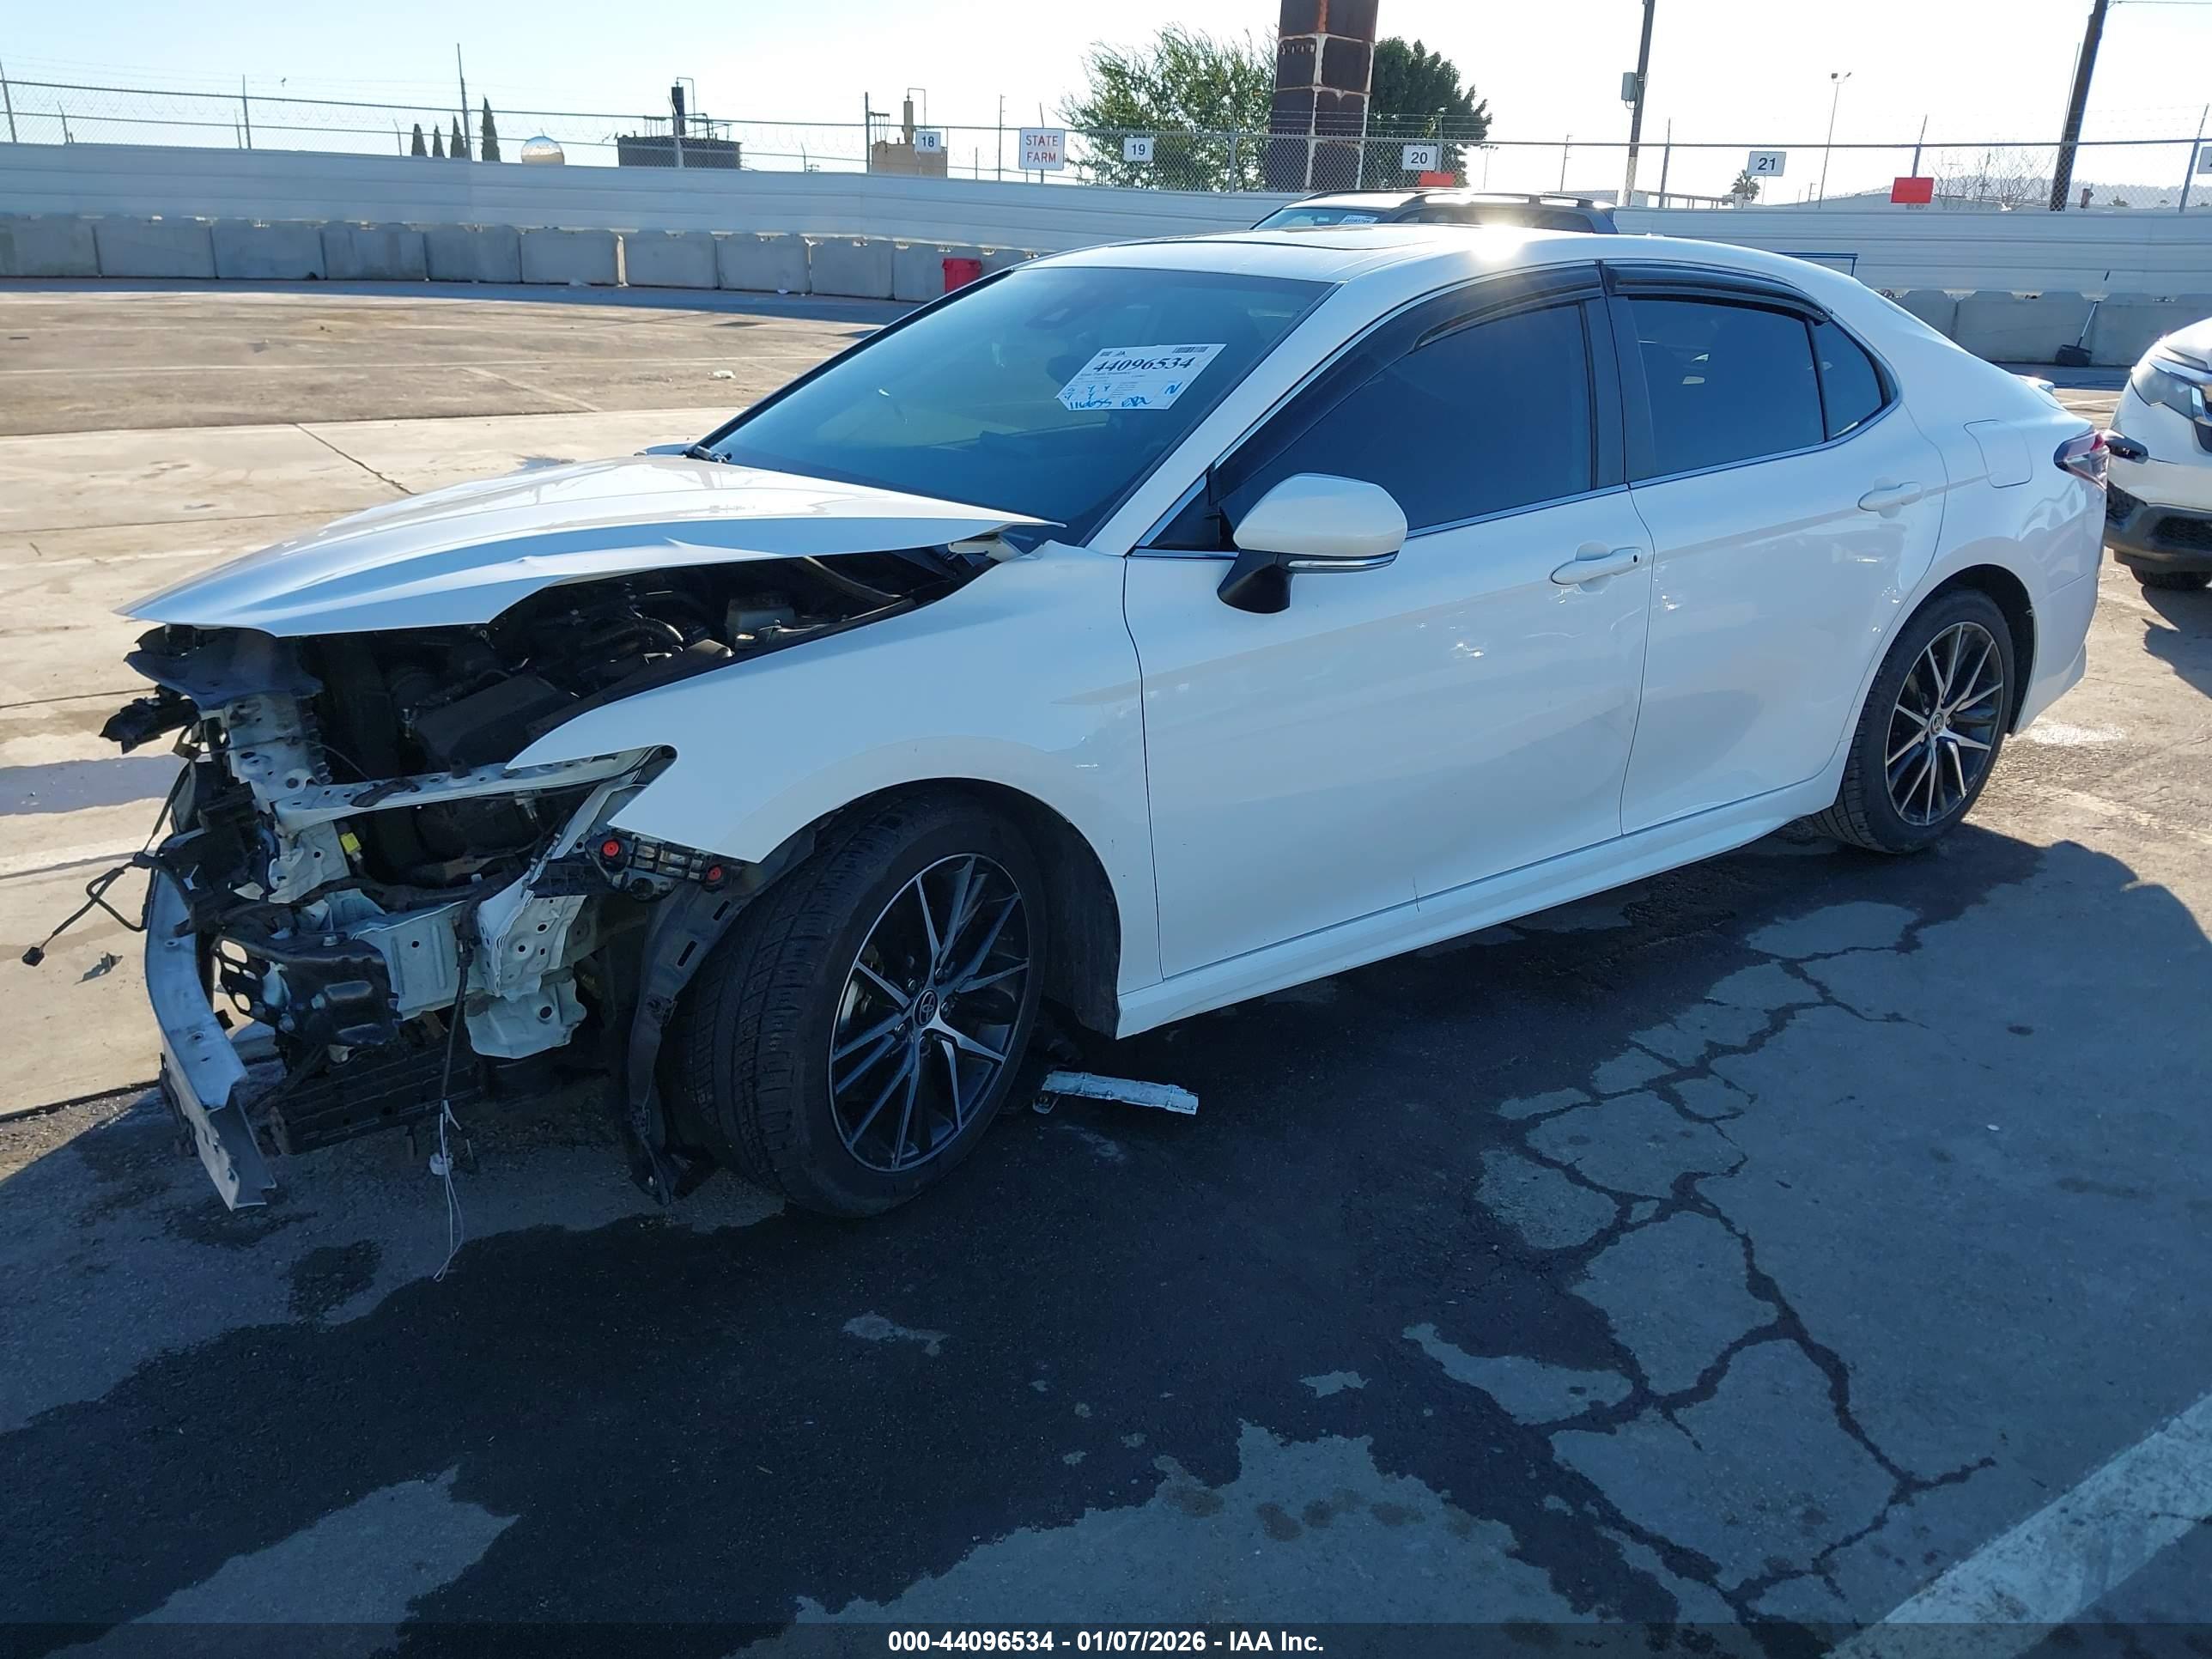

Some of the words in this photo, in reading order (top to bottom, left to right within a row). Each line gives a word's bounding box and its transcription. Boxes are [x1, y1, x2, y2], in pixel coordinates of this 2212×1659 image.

[921, 136, 935, 148] 18
[1025, 135, 1059, 147] STATE
[1131, 143, 1146, 156] 19
[1026, 151, 1057, 164] FARM
[1411, 152, 1428, 164] 20
[1758, 158, 1776, 170] 21
[1093, 356, 1196, 373] 44096534
